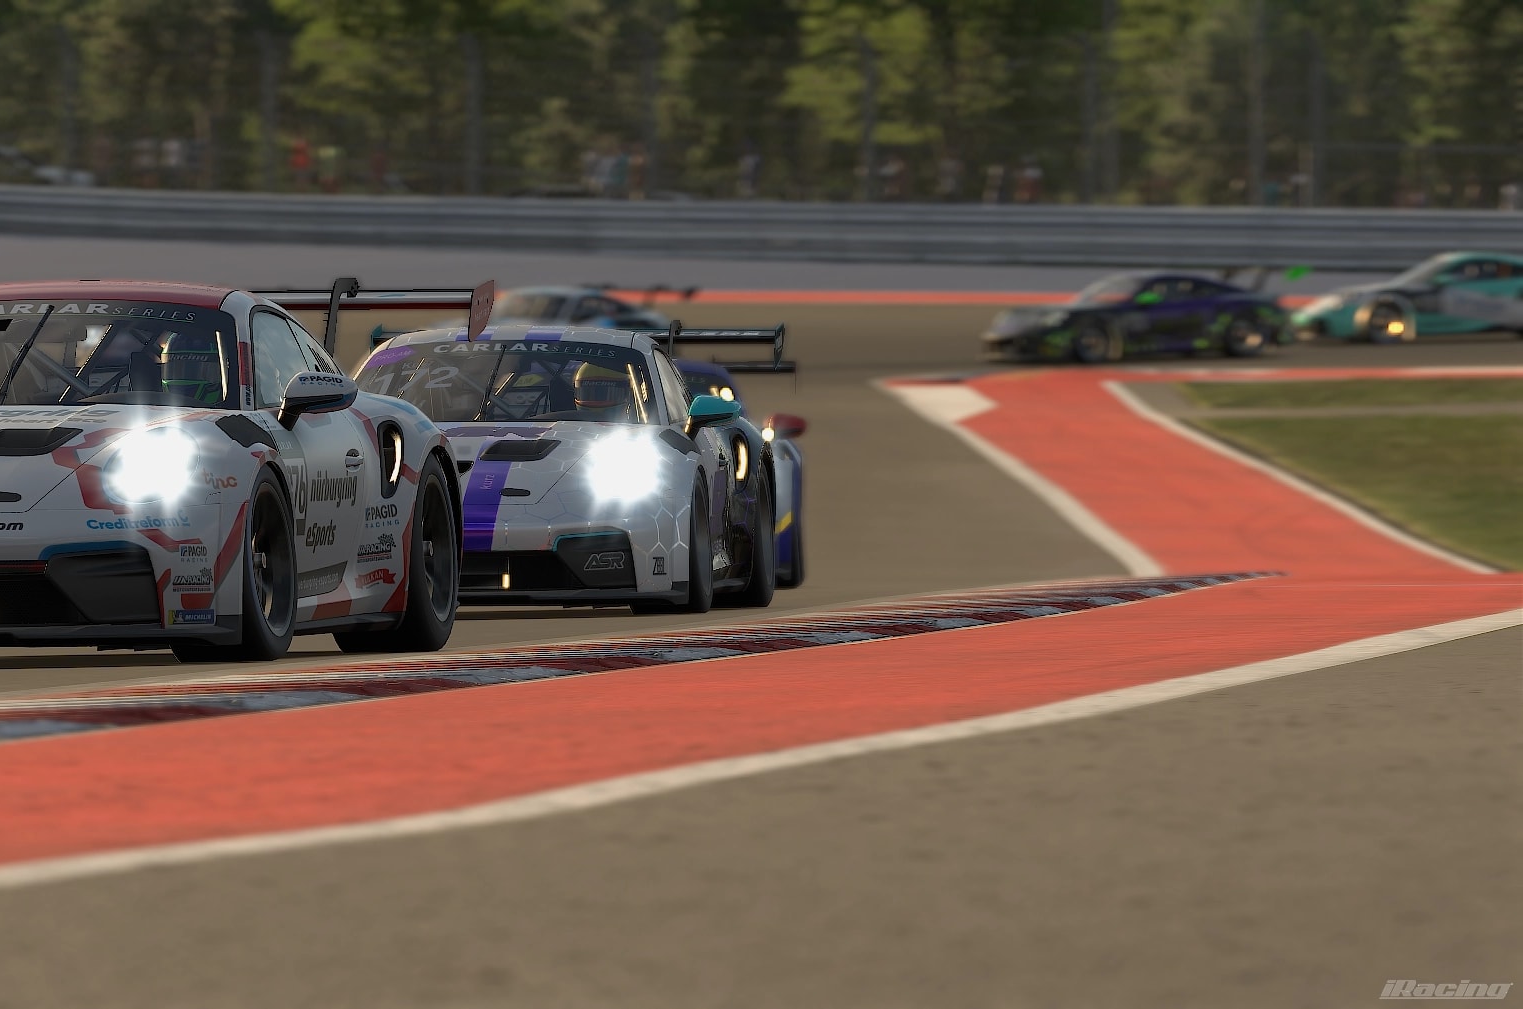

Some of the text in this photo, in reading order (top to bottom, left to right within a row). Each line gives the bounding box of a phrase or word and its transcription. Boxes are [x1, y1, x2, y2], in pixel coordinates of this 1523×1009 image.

[112, 307, 196, 321] SERIES
[310, 374, 343, 384] PAGID
[371, 504, 398, 521] PAGID
[188, 546, 208, 557] PAGID
[584, 552, 625, 570] ASR
